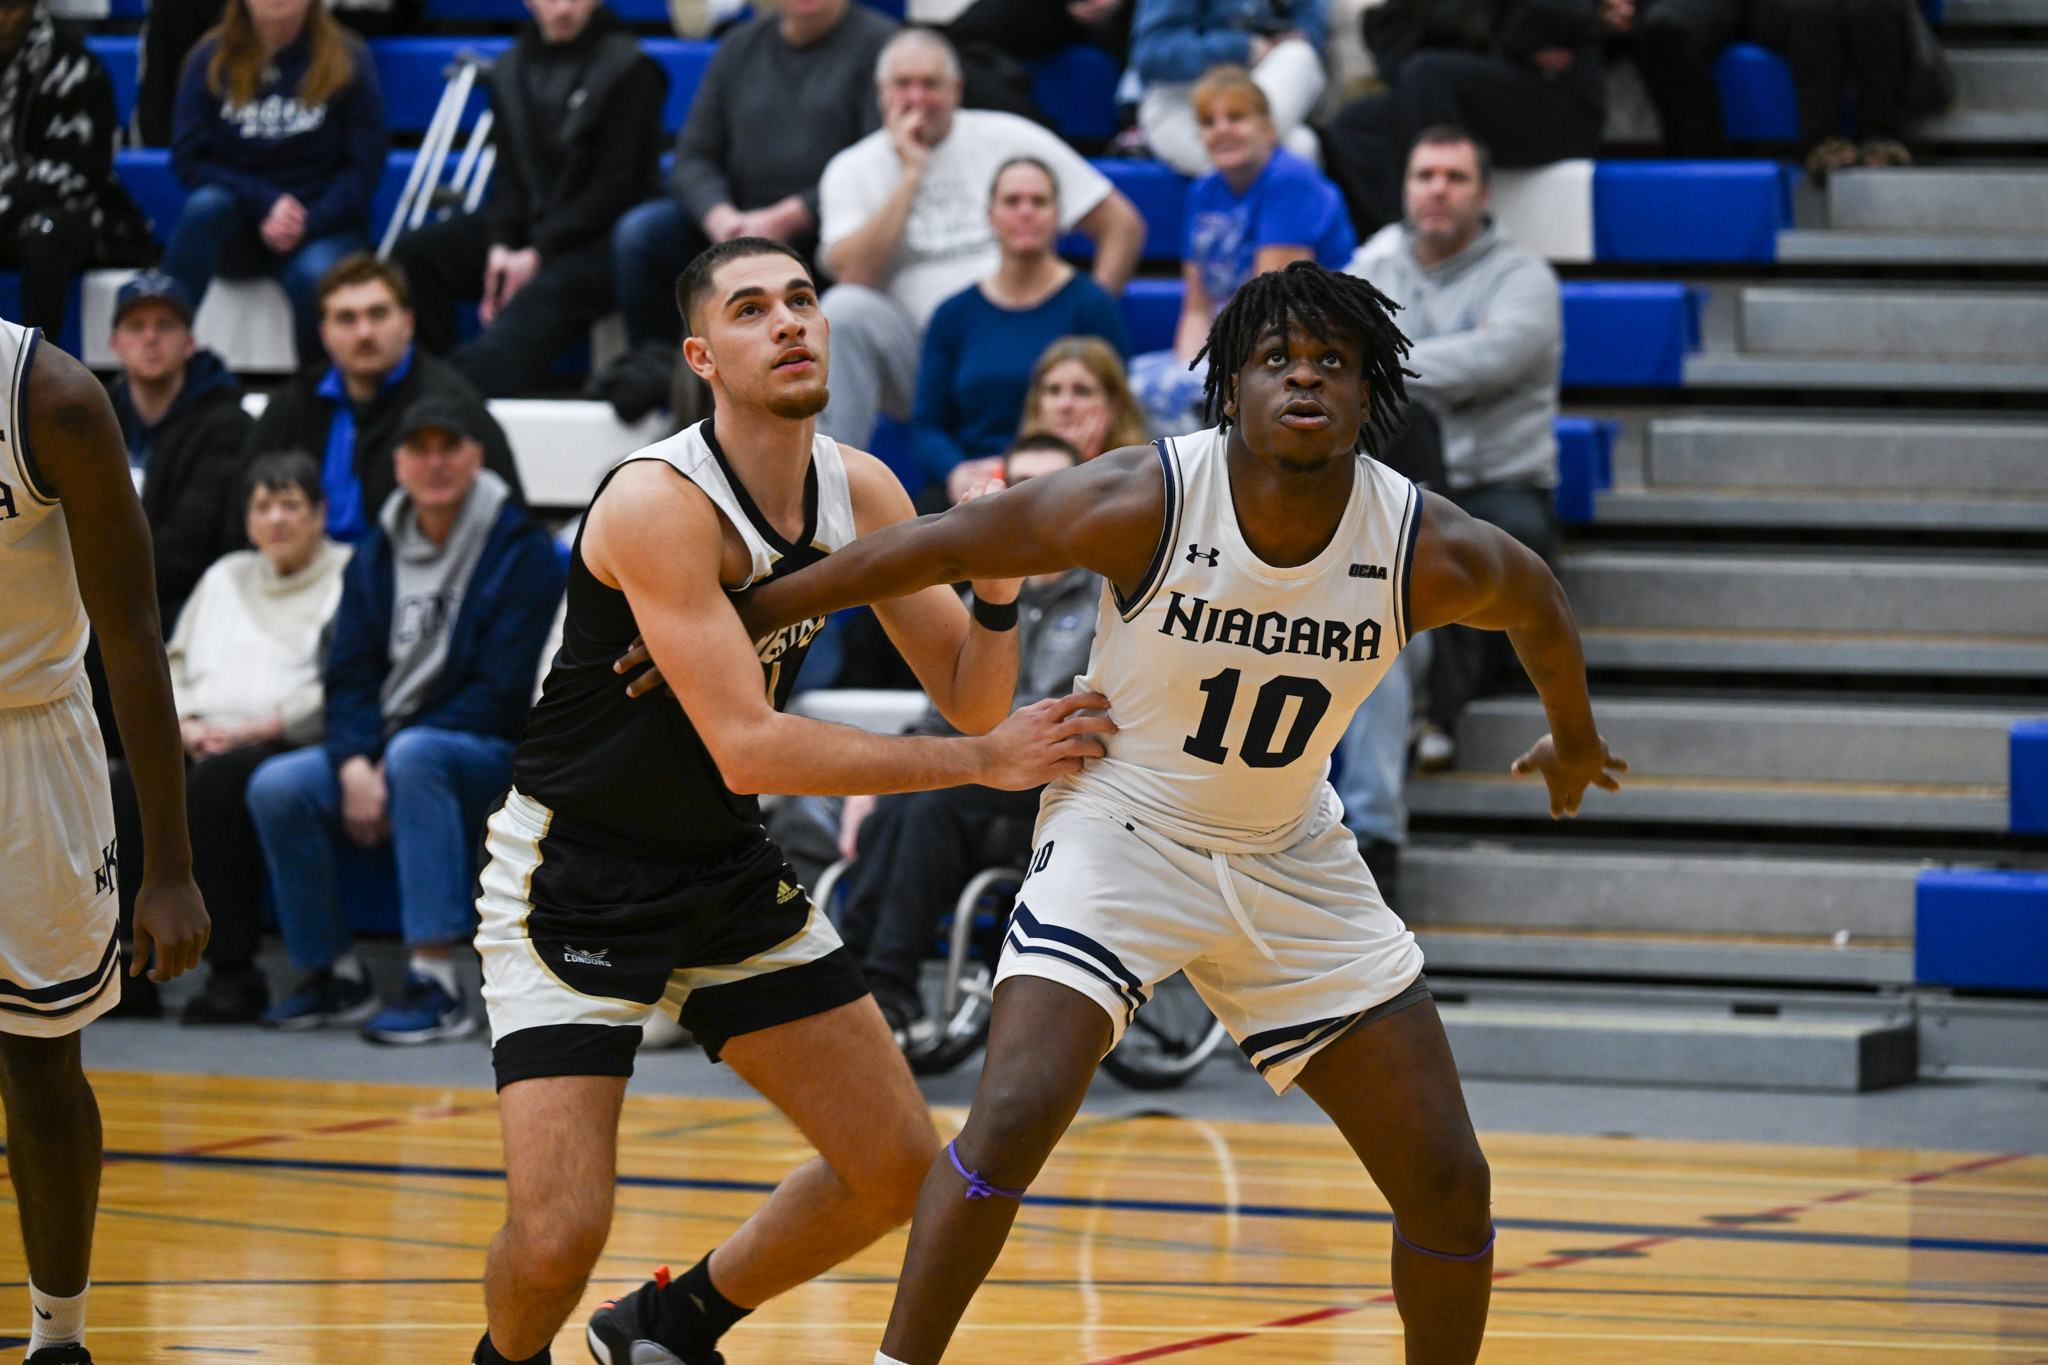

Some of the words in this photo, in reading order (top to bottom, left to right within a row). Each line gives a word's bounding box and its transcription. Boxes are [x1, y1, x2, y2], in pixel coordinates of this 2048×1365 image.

[1348, 563, 1387, 580] OCAA
[1158, 591, 1382, 662] NIAGARA
[1182, 667, 1332, 768] 10
[1025, 840, 1055, 881] 10
[564, 953, 612, 967] CONDORS
